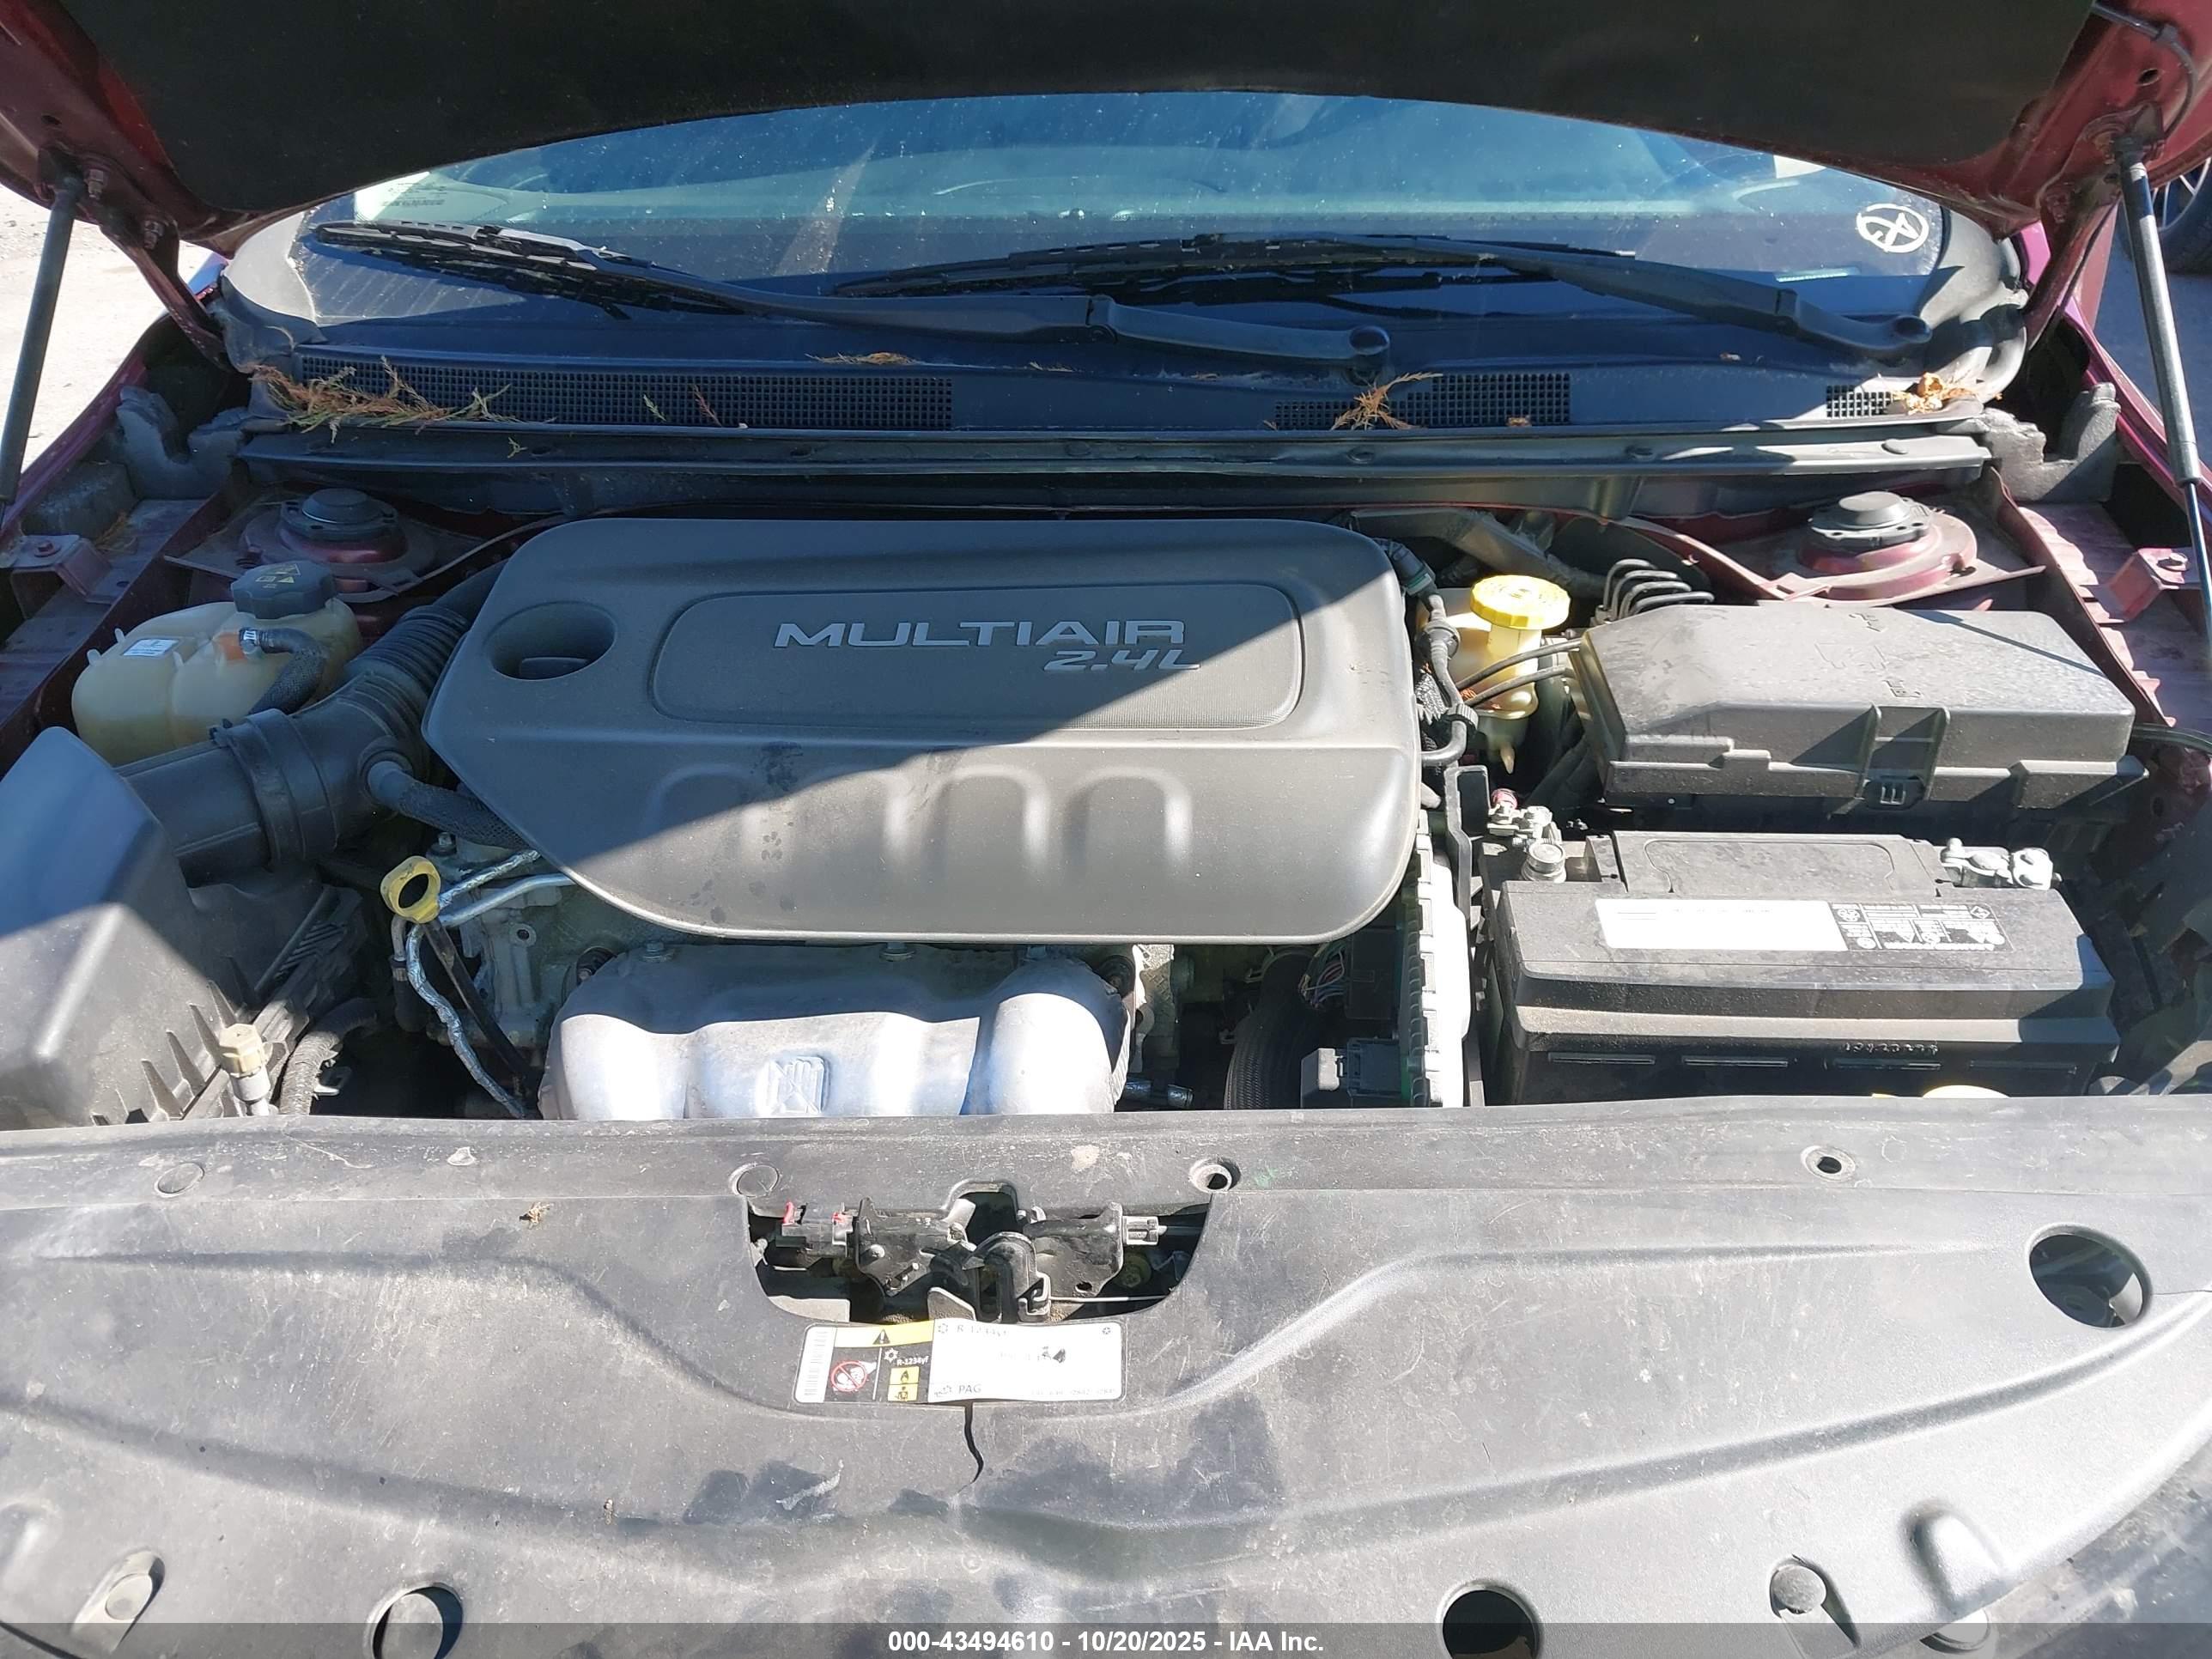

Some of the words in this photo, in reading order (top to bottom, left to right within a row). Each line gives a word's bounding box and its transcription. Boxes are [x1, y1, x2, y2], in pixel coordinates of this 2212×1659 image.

[774, 620, 1185, 647] MULTIAIR
[1042, 649, 1201, 672] 2.4L
[896, 1355, 929, 1366] R-1234yf
[958, 1383, 981, 1394] PAG
